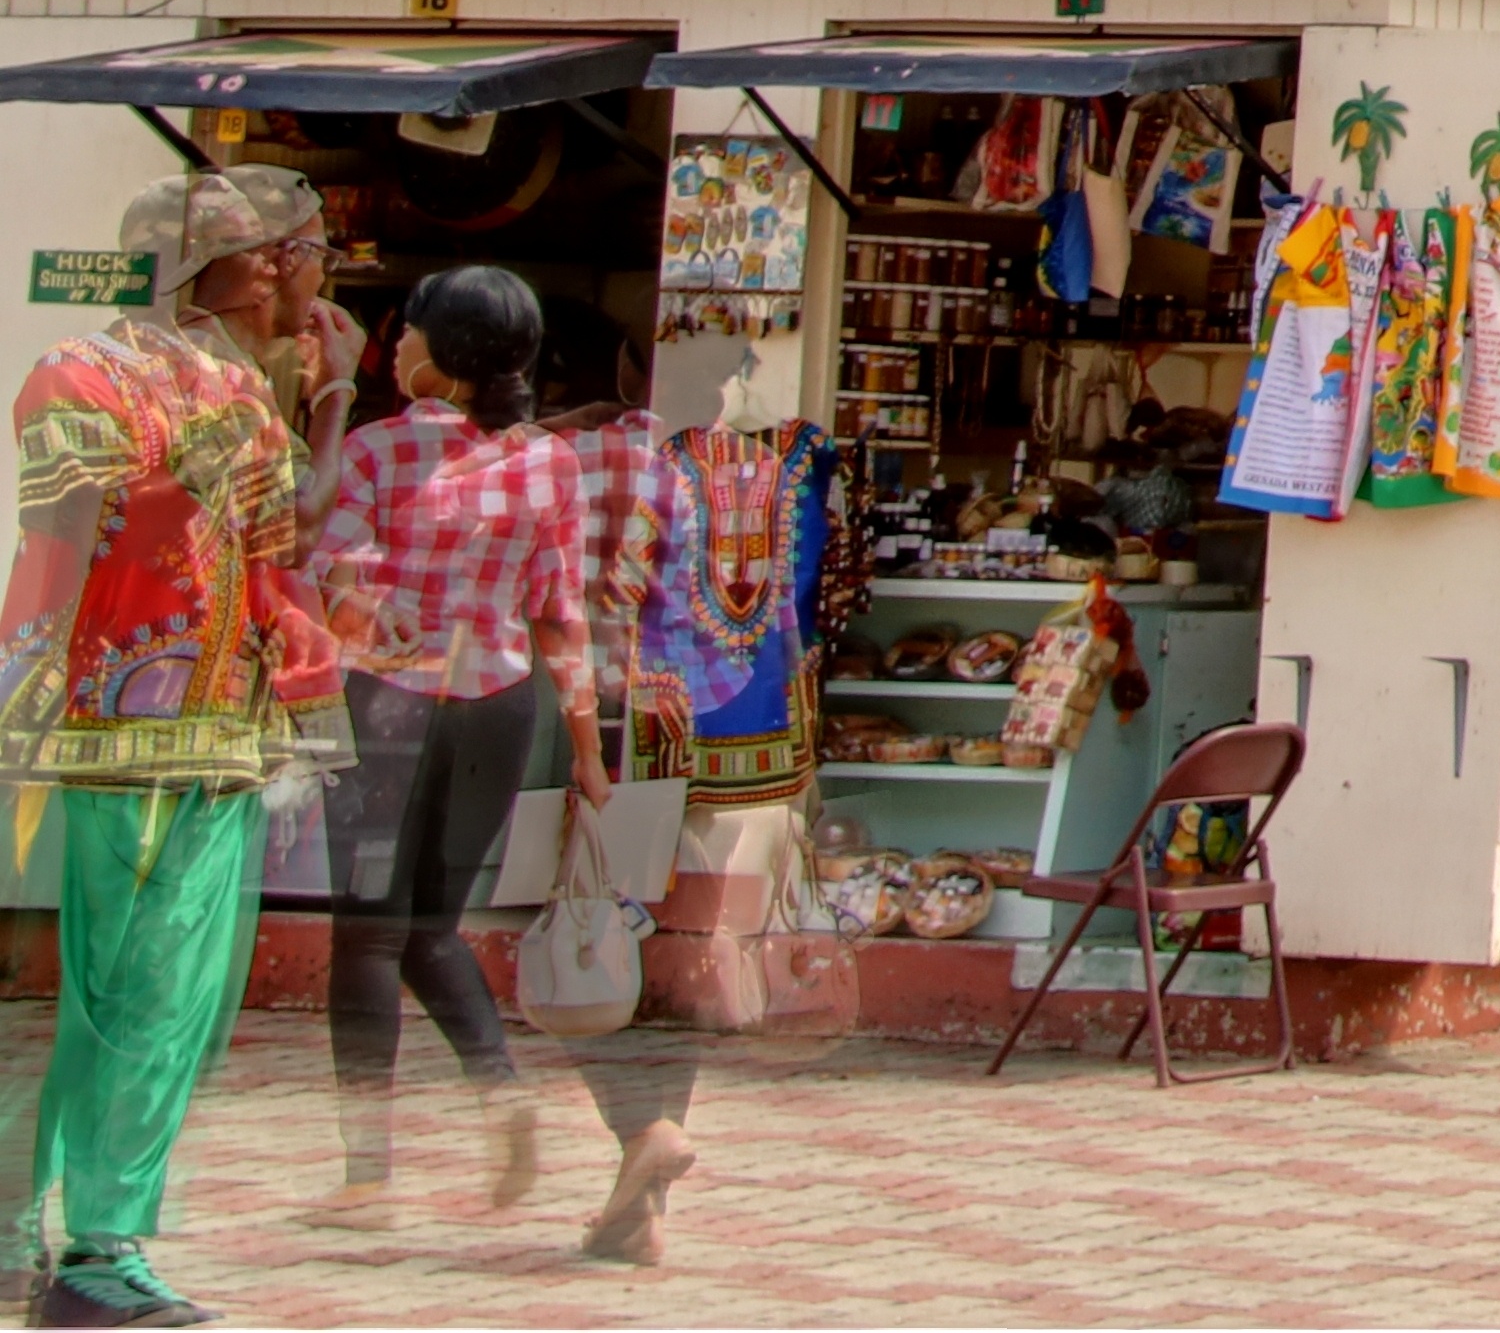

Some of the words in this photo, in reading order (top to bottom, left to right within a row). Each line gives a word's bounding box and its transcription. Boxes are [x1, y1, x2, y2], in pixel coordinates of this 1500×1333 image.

[865, 94, 897, 126] 17
[223, 113, 245, 135] 18
[39, 269, 77, 288] STEEL
[79, 273, 105, 289] PAN
